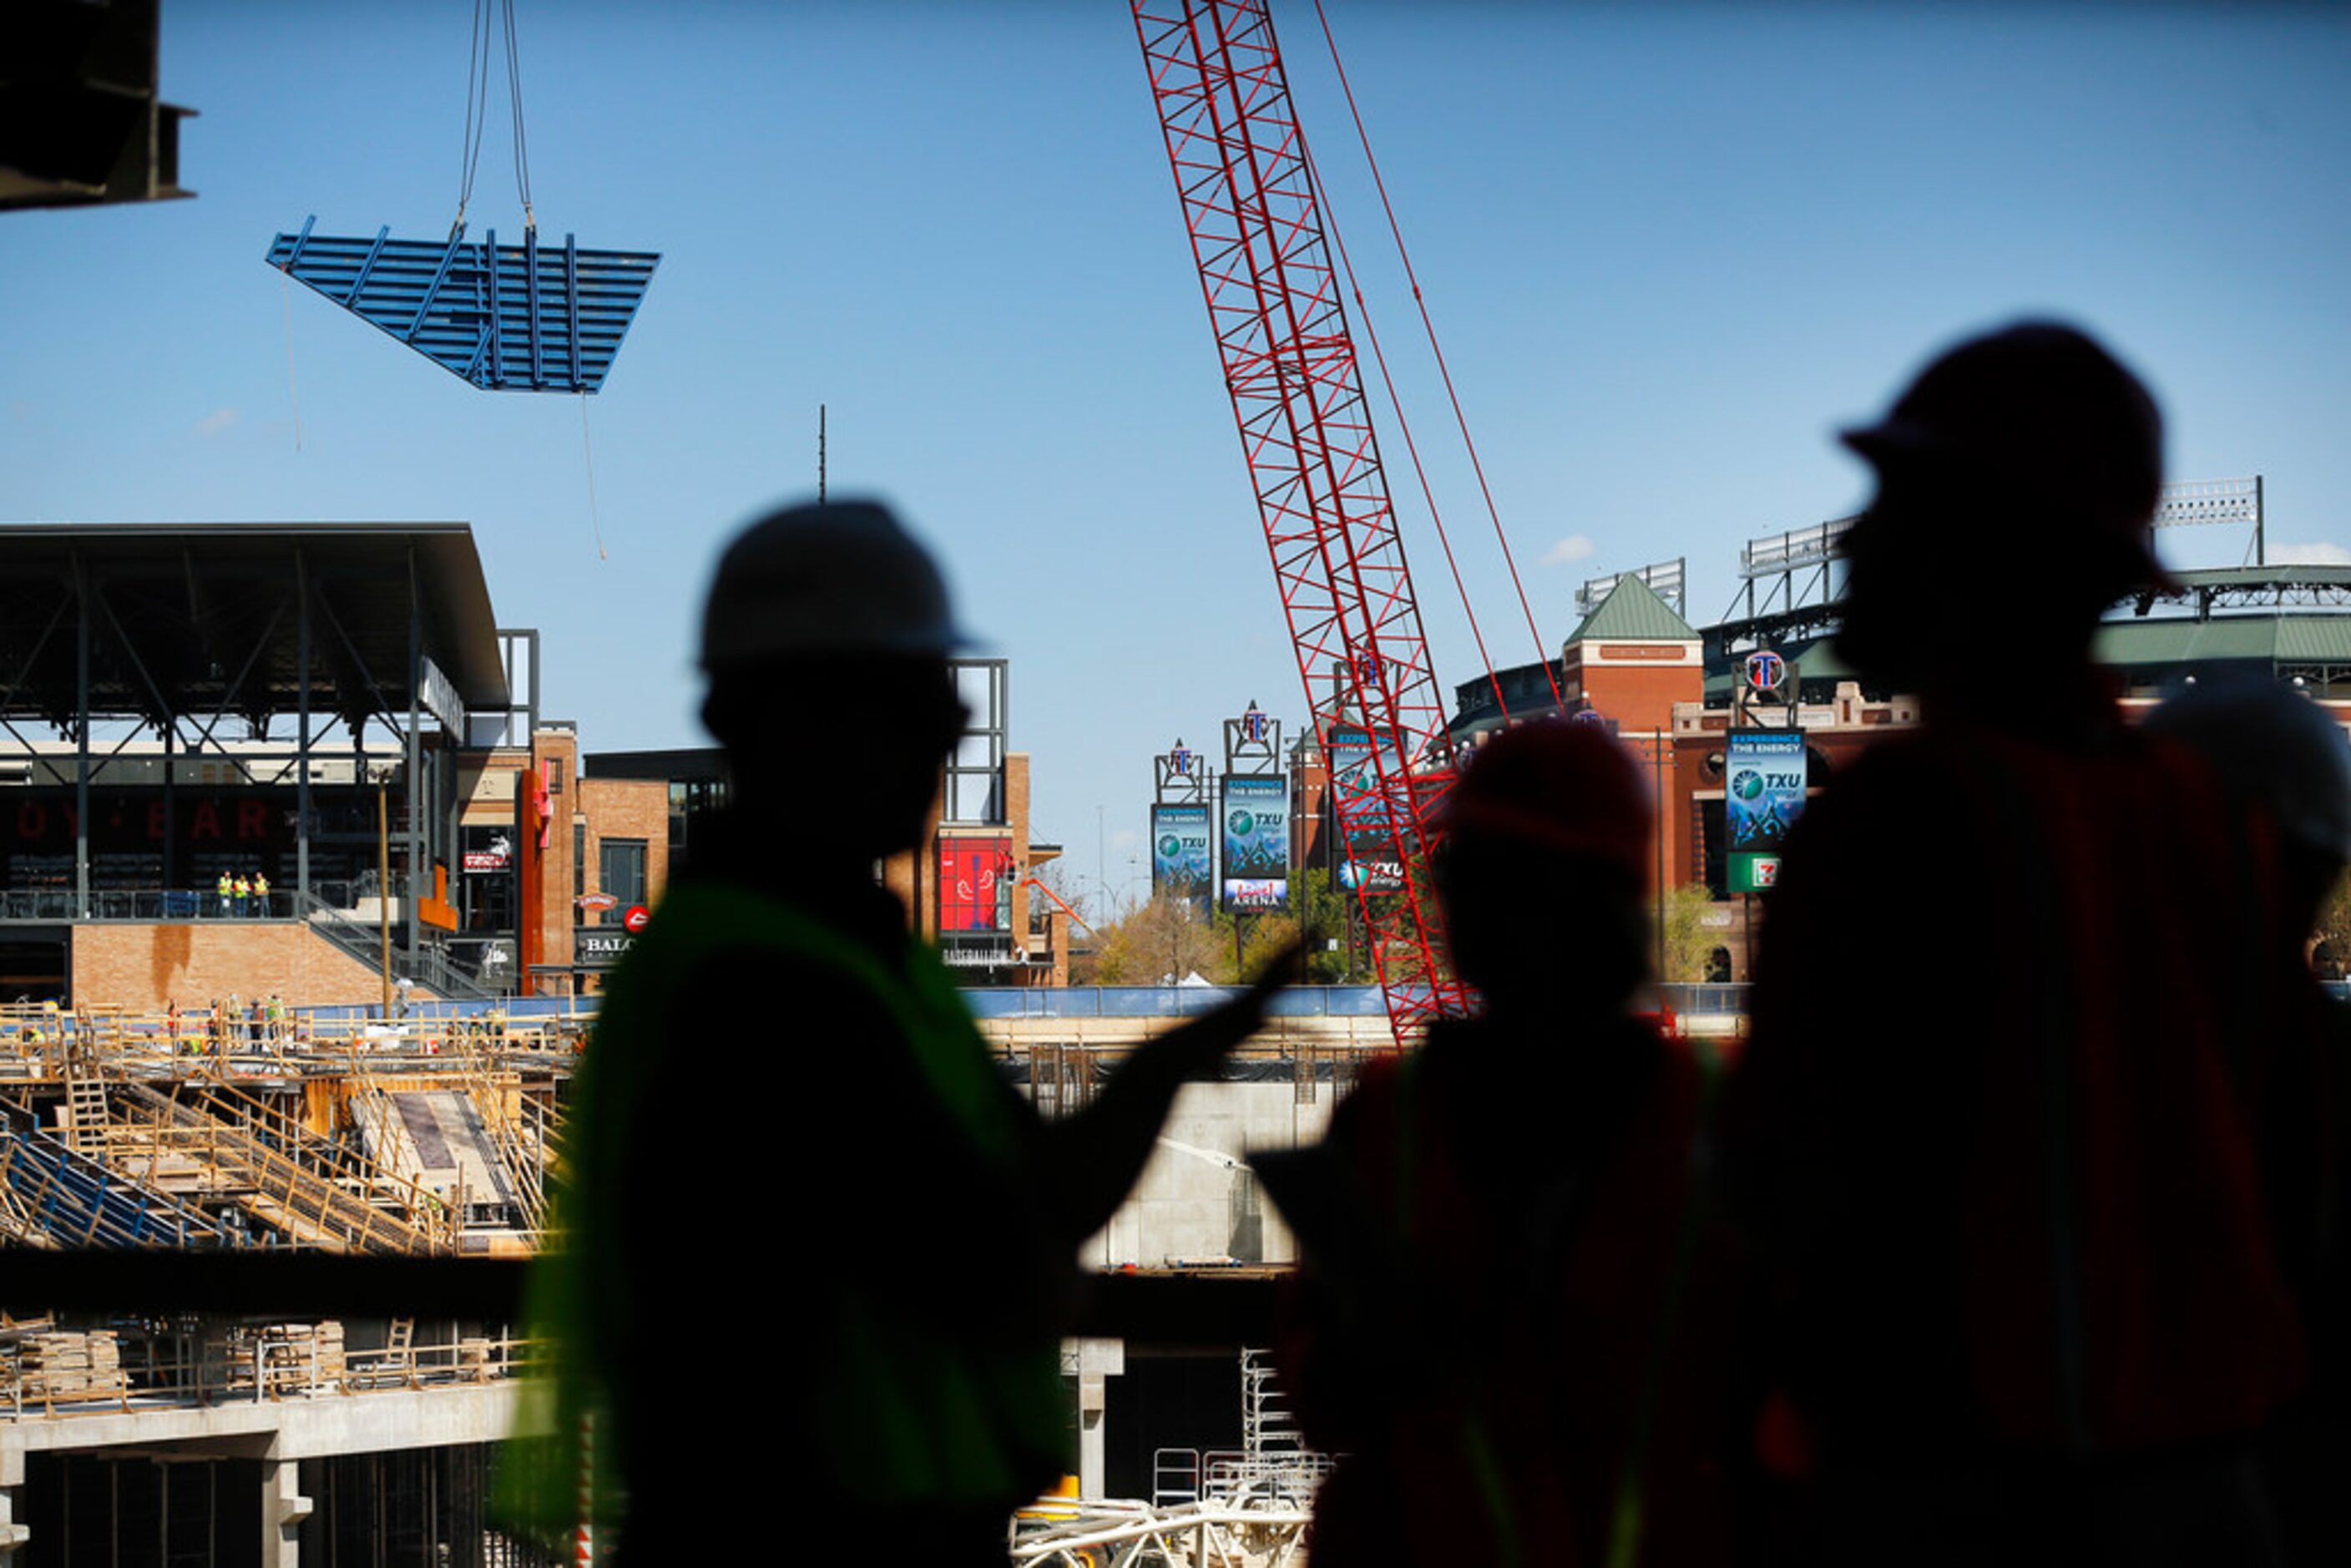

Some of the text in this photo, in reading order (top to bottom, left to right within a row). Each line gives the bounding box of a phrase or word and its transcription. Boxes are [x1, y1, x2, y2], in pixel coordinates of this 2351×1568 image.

[1731, 734, 1801, 743] EXPERIENCE
[1732, 743, 1800, 752] THE ENERGY
[1228, 780, 1283, 788] EXPERIENCE
[1765, 773, 1801, 788] TXU
[1255, 812, 1284, 826] TXU
[1181, 837, 1206, 848] TXU
[1232, 896, 1280, 906] ARENA
